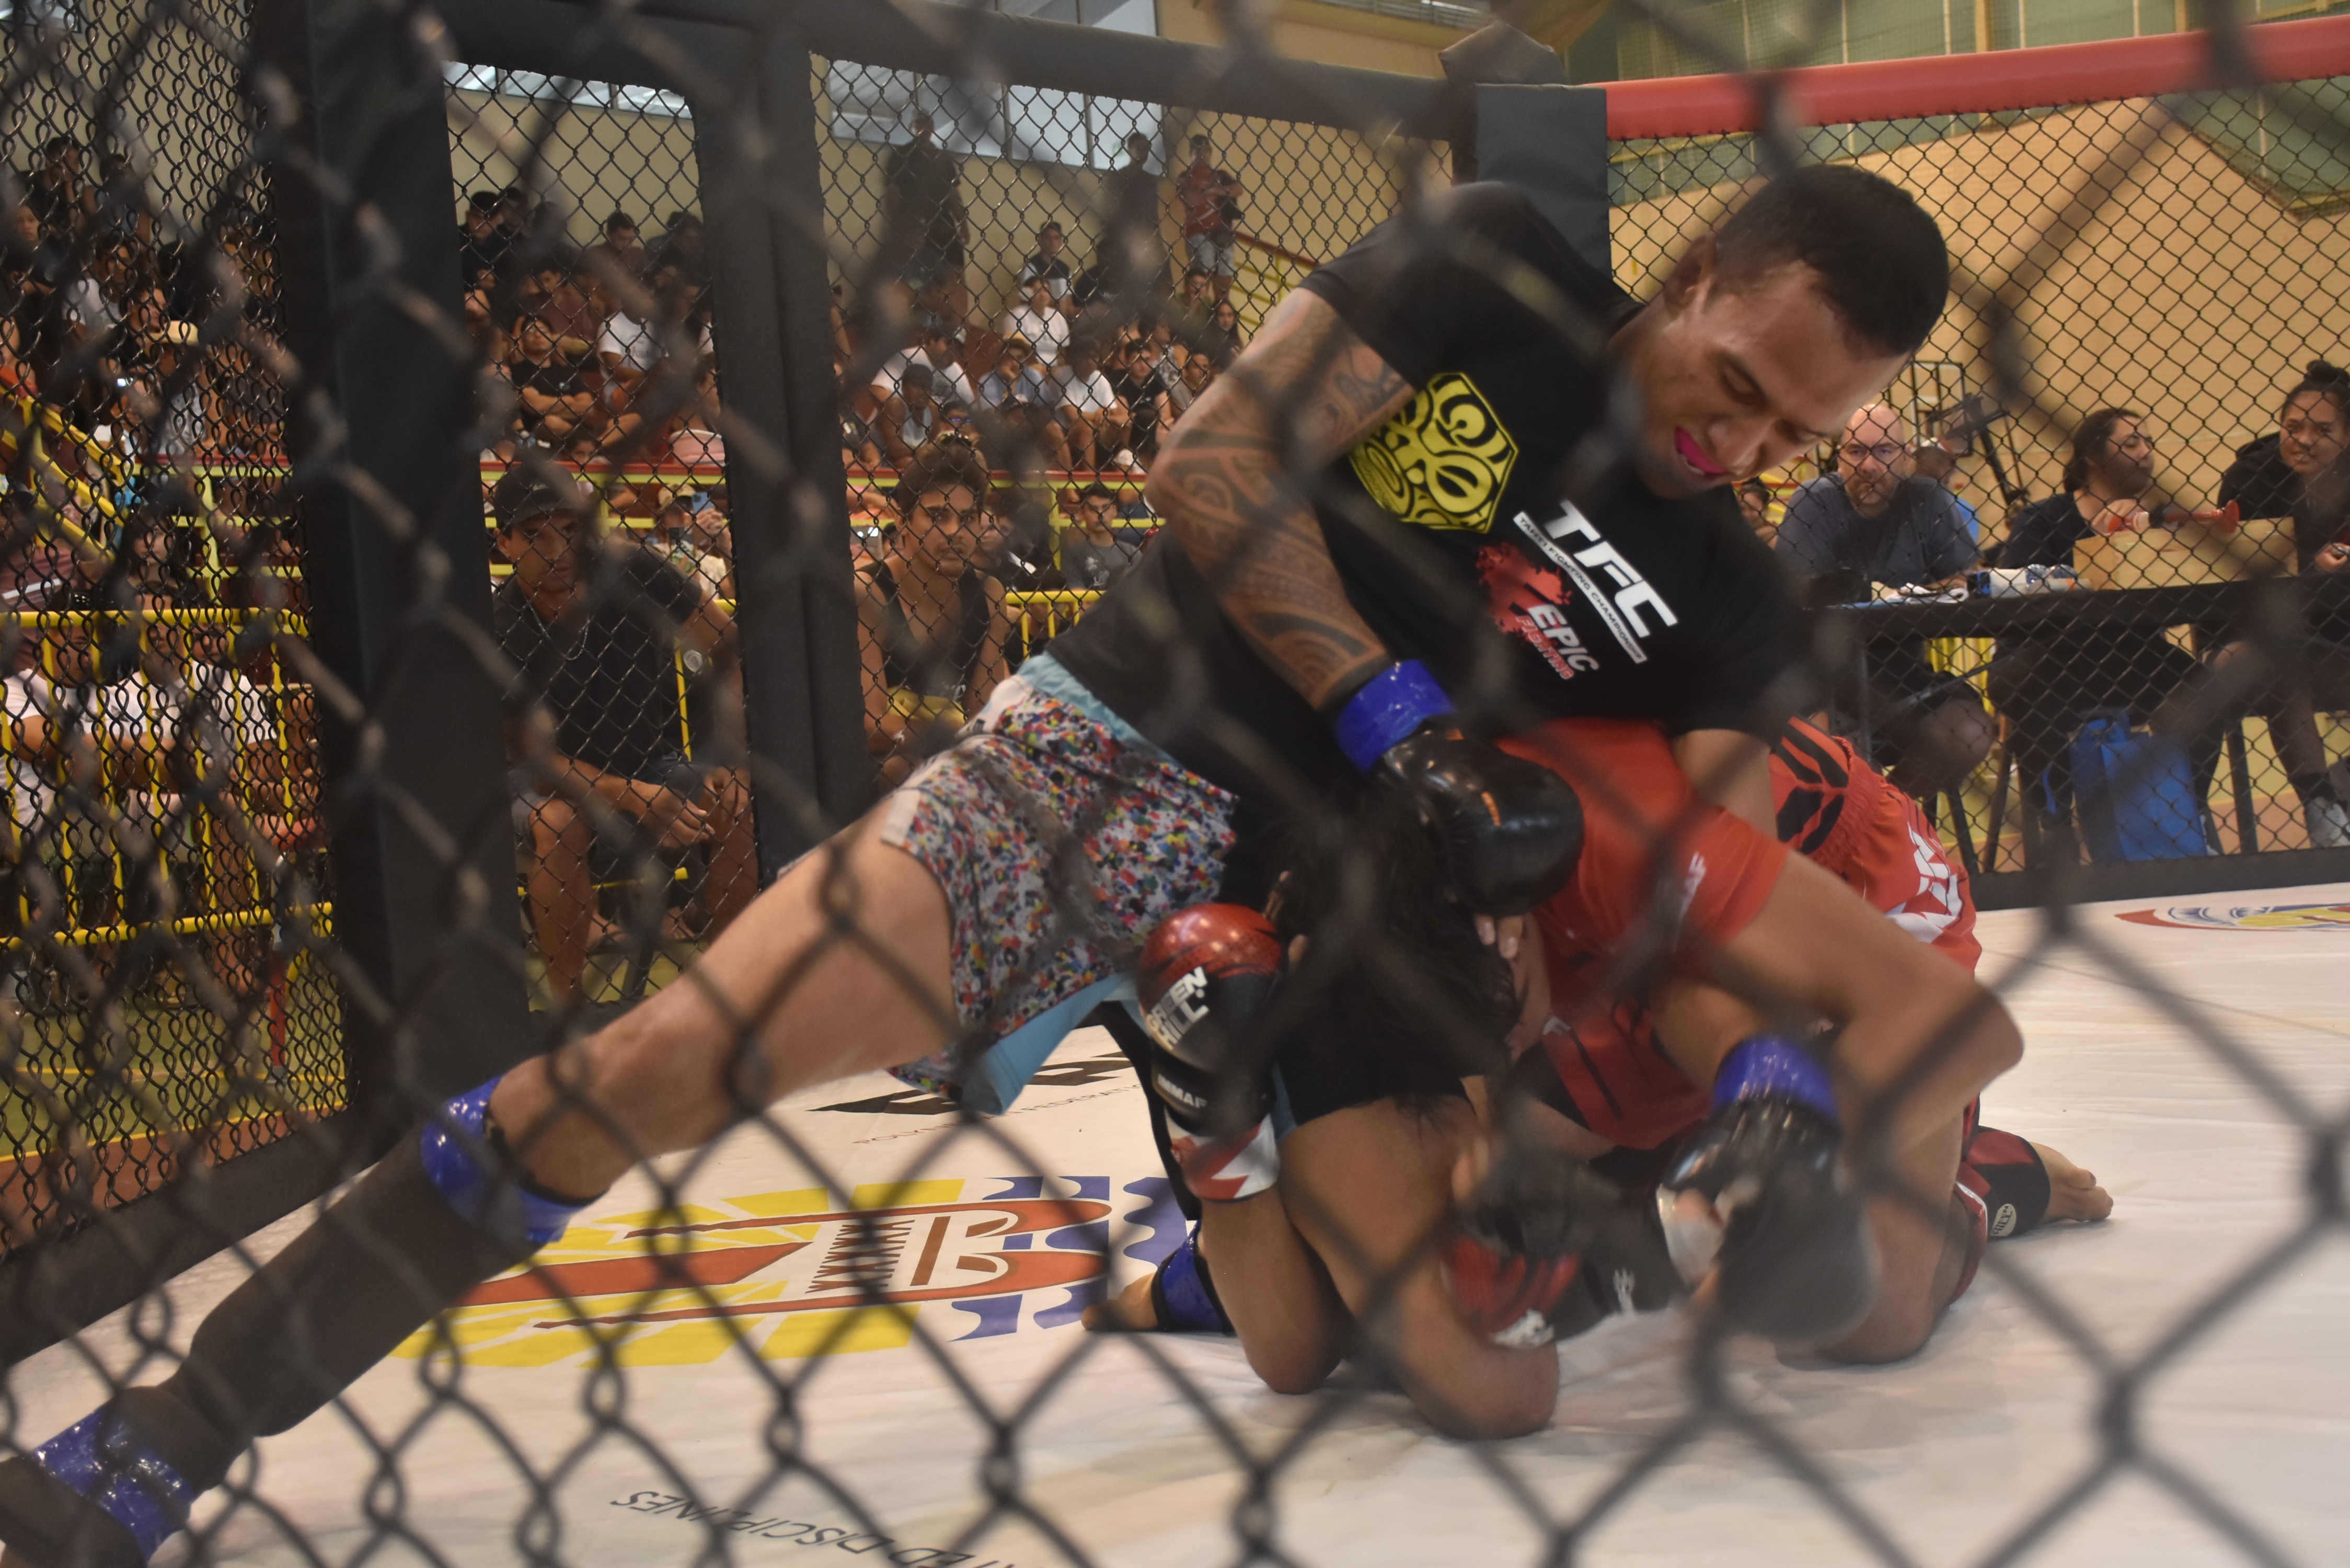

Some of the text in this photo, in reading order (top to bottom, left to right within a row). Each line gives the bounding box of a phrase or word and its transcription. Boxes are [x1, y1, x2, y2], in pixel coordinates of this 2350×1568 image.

[1518, 516, 1548, 547] TAHITI
[1549, 546, 1591, 591] FIGHTING
[1543, 499, 1678, 638] TFC
[1515, 615, 1574, 680] FIGHTING
[1528, 604, 1600, 672] EPIC
[1146, 965, 1208, 1029] GREEN
[1151, 997, 1210, 1051] HILL
[609, 1491, 895, 1554] DISCIPLINES
